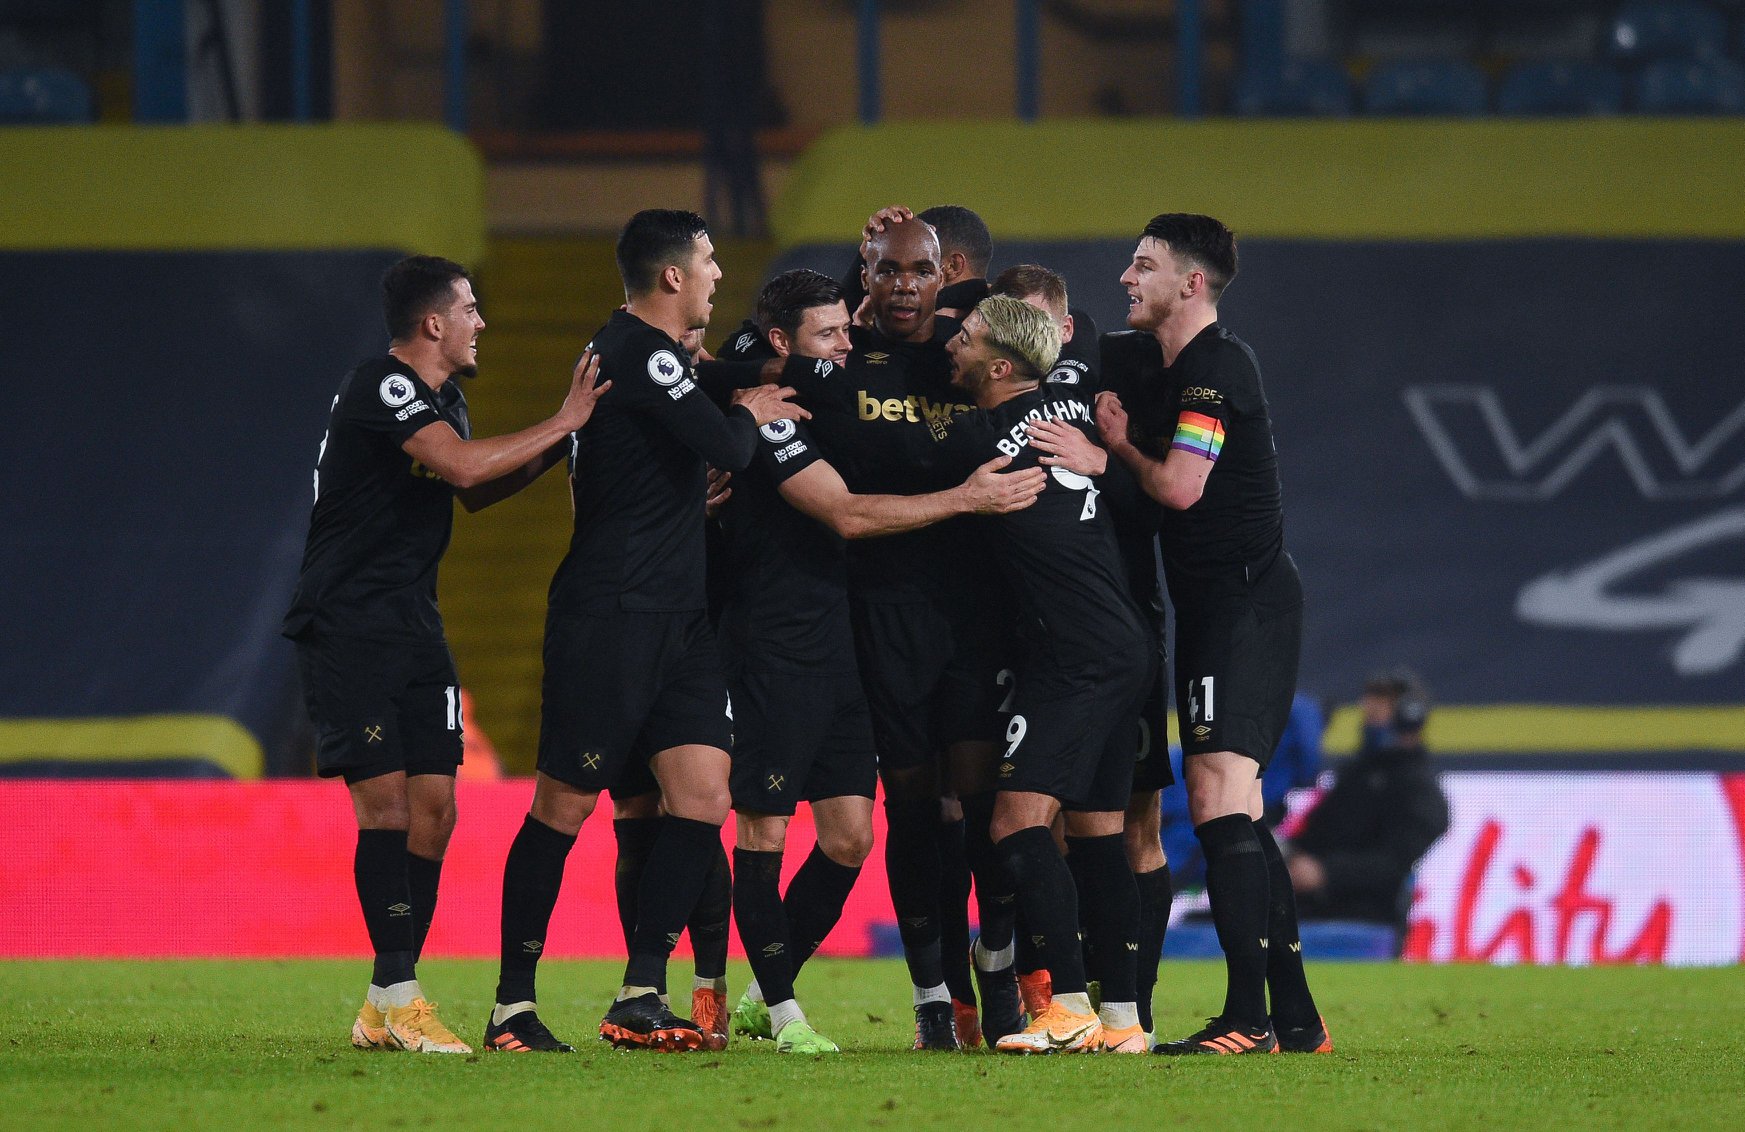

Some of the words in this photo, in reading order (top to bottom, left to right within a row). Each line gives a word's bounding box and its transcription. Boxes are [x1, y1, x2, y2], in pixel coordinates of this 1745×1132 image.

[785, 440, 803, 452] room
[1188, 676, 1214, 723] 41
[1004, 714, 1027, 758] 9
